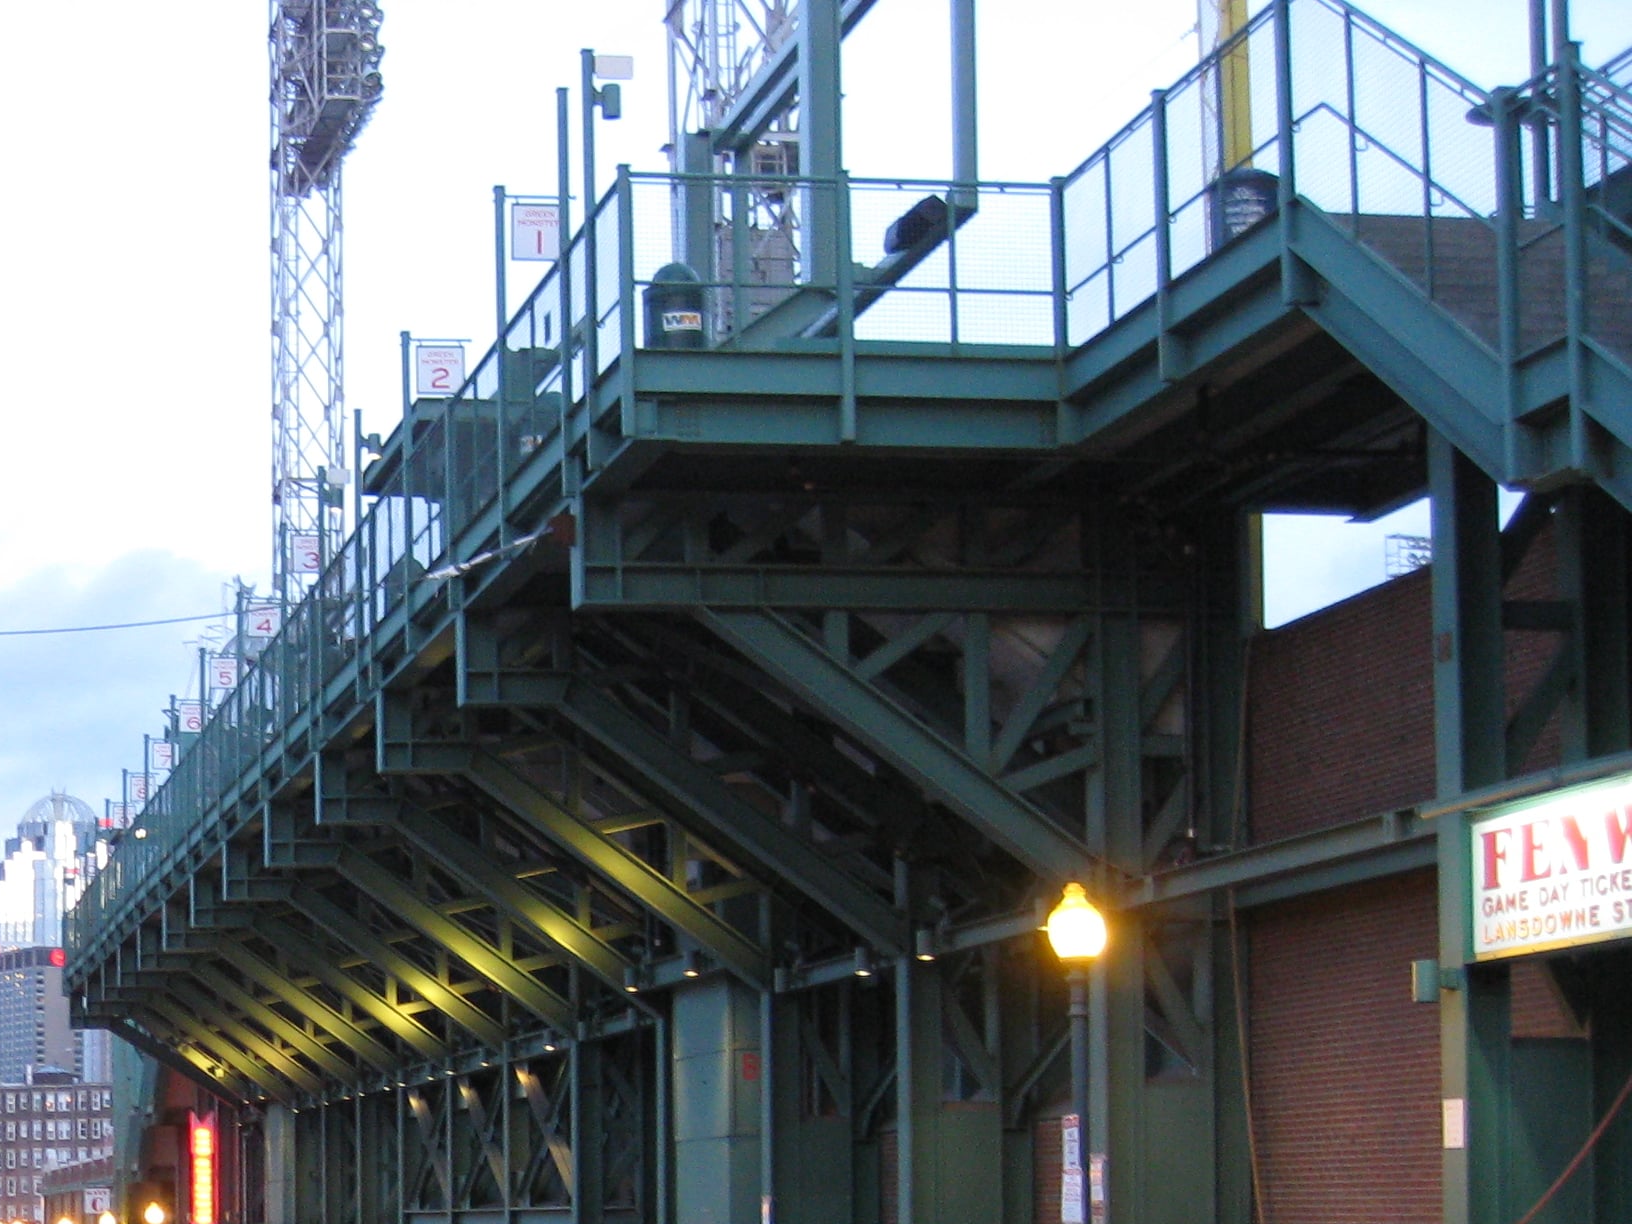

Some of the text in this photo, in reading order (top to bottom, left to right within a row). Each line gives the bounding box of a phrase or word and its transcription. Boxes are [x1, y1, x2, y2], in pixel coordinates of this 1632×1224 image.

[536, 230, 543, 254] 1
[431, 367, 451, 389] 2
[302, 551, 320, 569] 3
[256, 618, 273, 633] 4
[218, 670, 233, 686] 5
[186, 716, 202, 730] 6
[1482, 890, 1529, 918] GAME
[1539, 882, 1571, 907] DAY
[1483, 904, 1601, 944] LANSDOWNE
